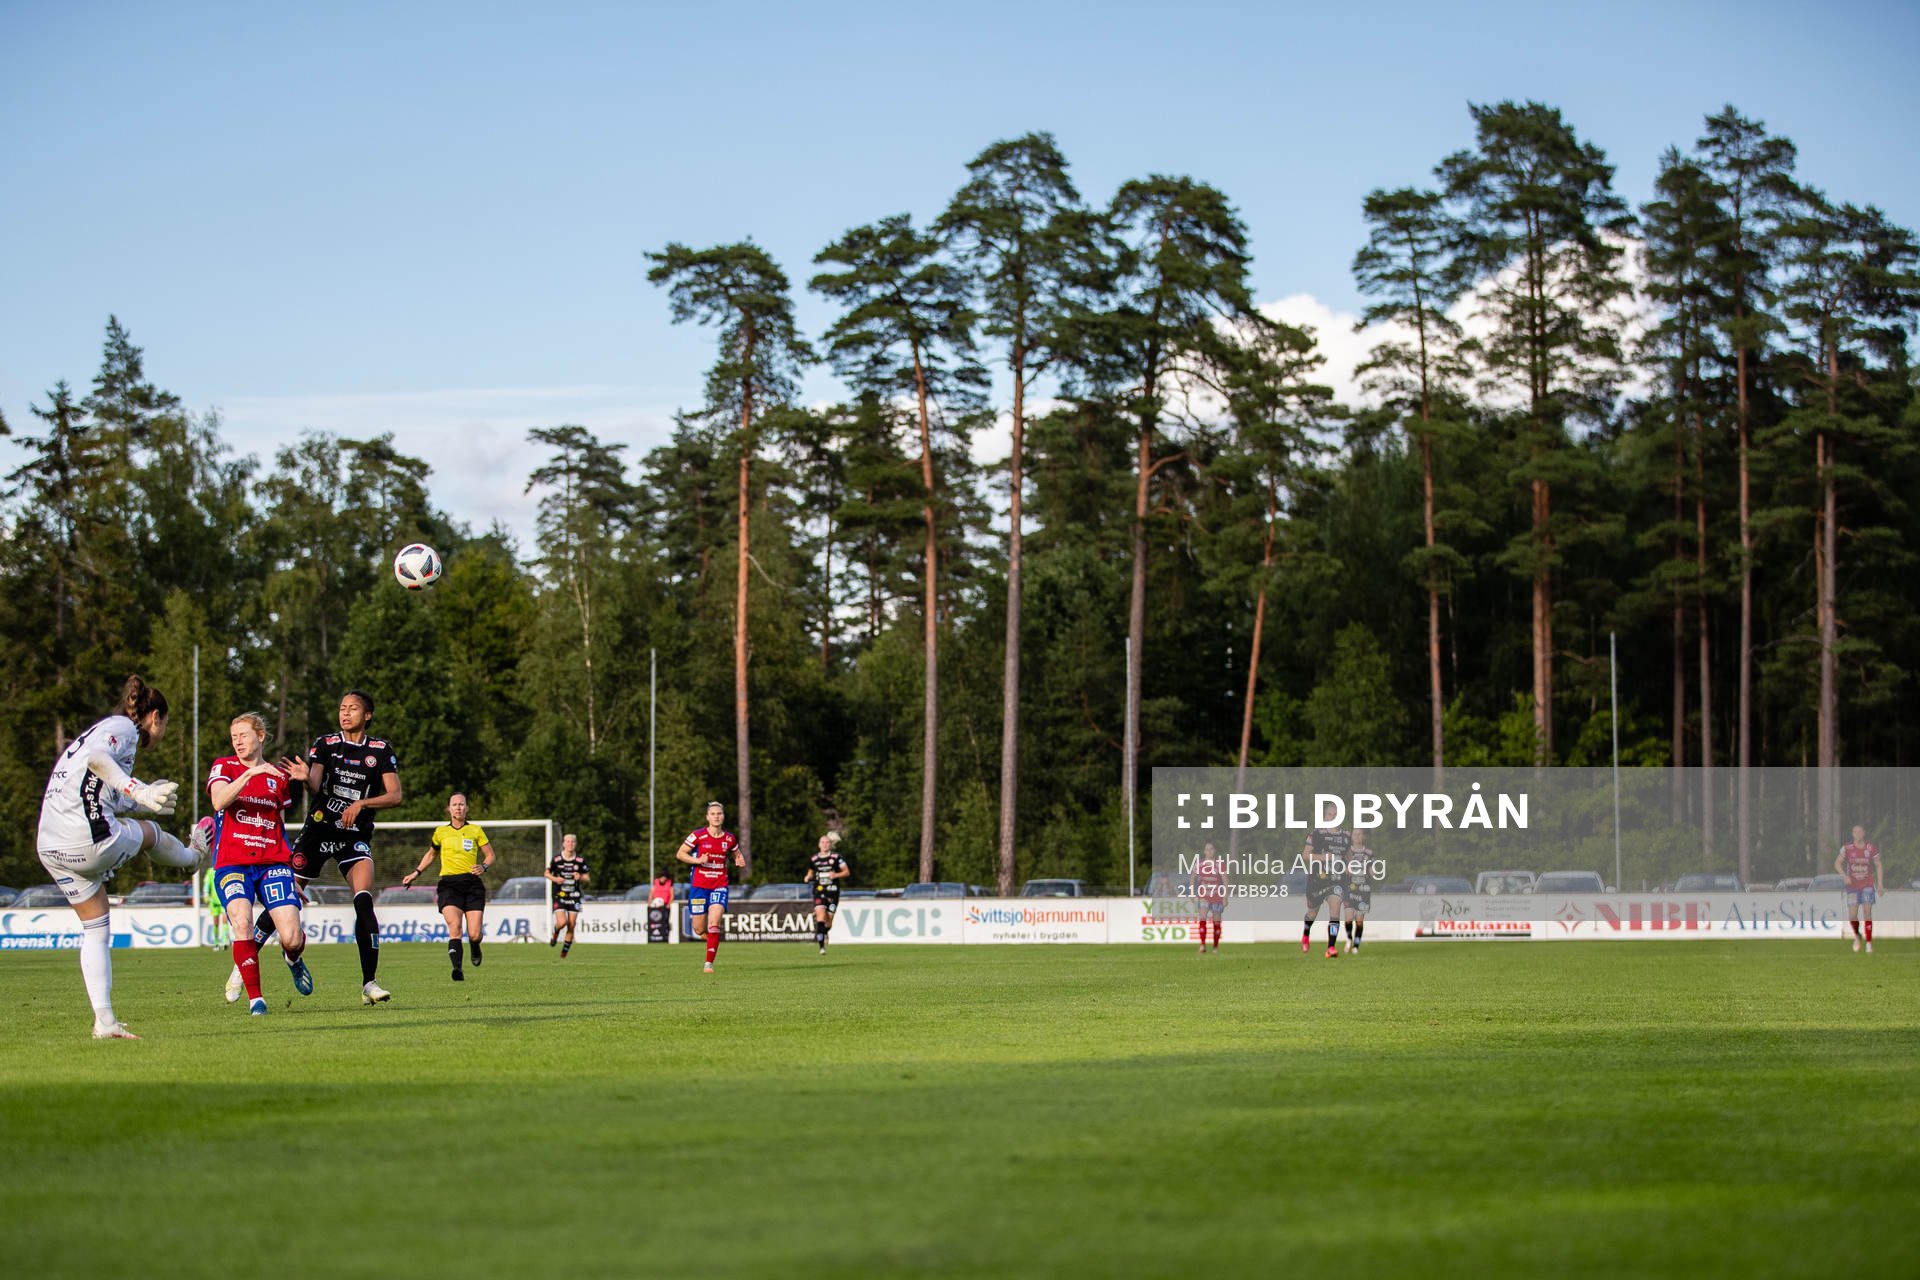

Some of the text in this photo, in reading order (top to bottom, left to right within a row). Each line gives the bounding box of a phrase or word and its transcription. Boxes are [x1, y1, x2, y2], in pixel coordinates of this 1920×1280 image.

[1440, 898, 1470, 917] Rör
[1594, 900, 1838, 931] NIBE AirSite
[496, 918, 530, 936] AB
[722, 913, 815, 932] T-REKLAM
[1, 934, 56, 948] svensk
[1039, 931, 1079, 941] bygden
[1142, 927, 1186, 940] SYD
